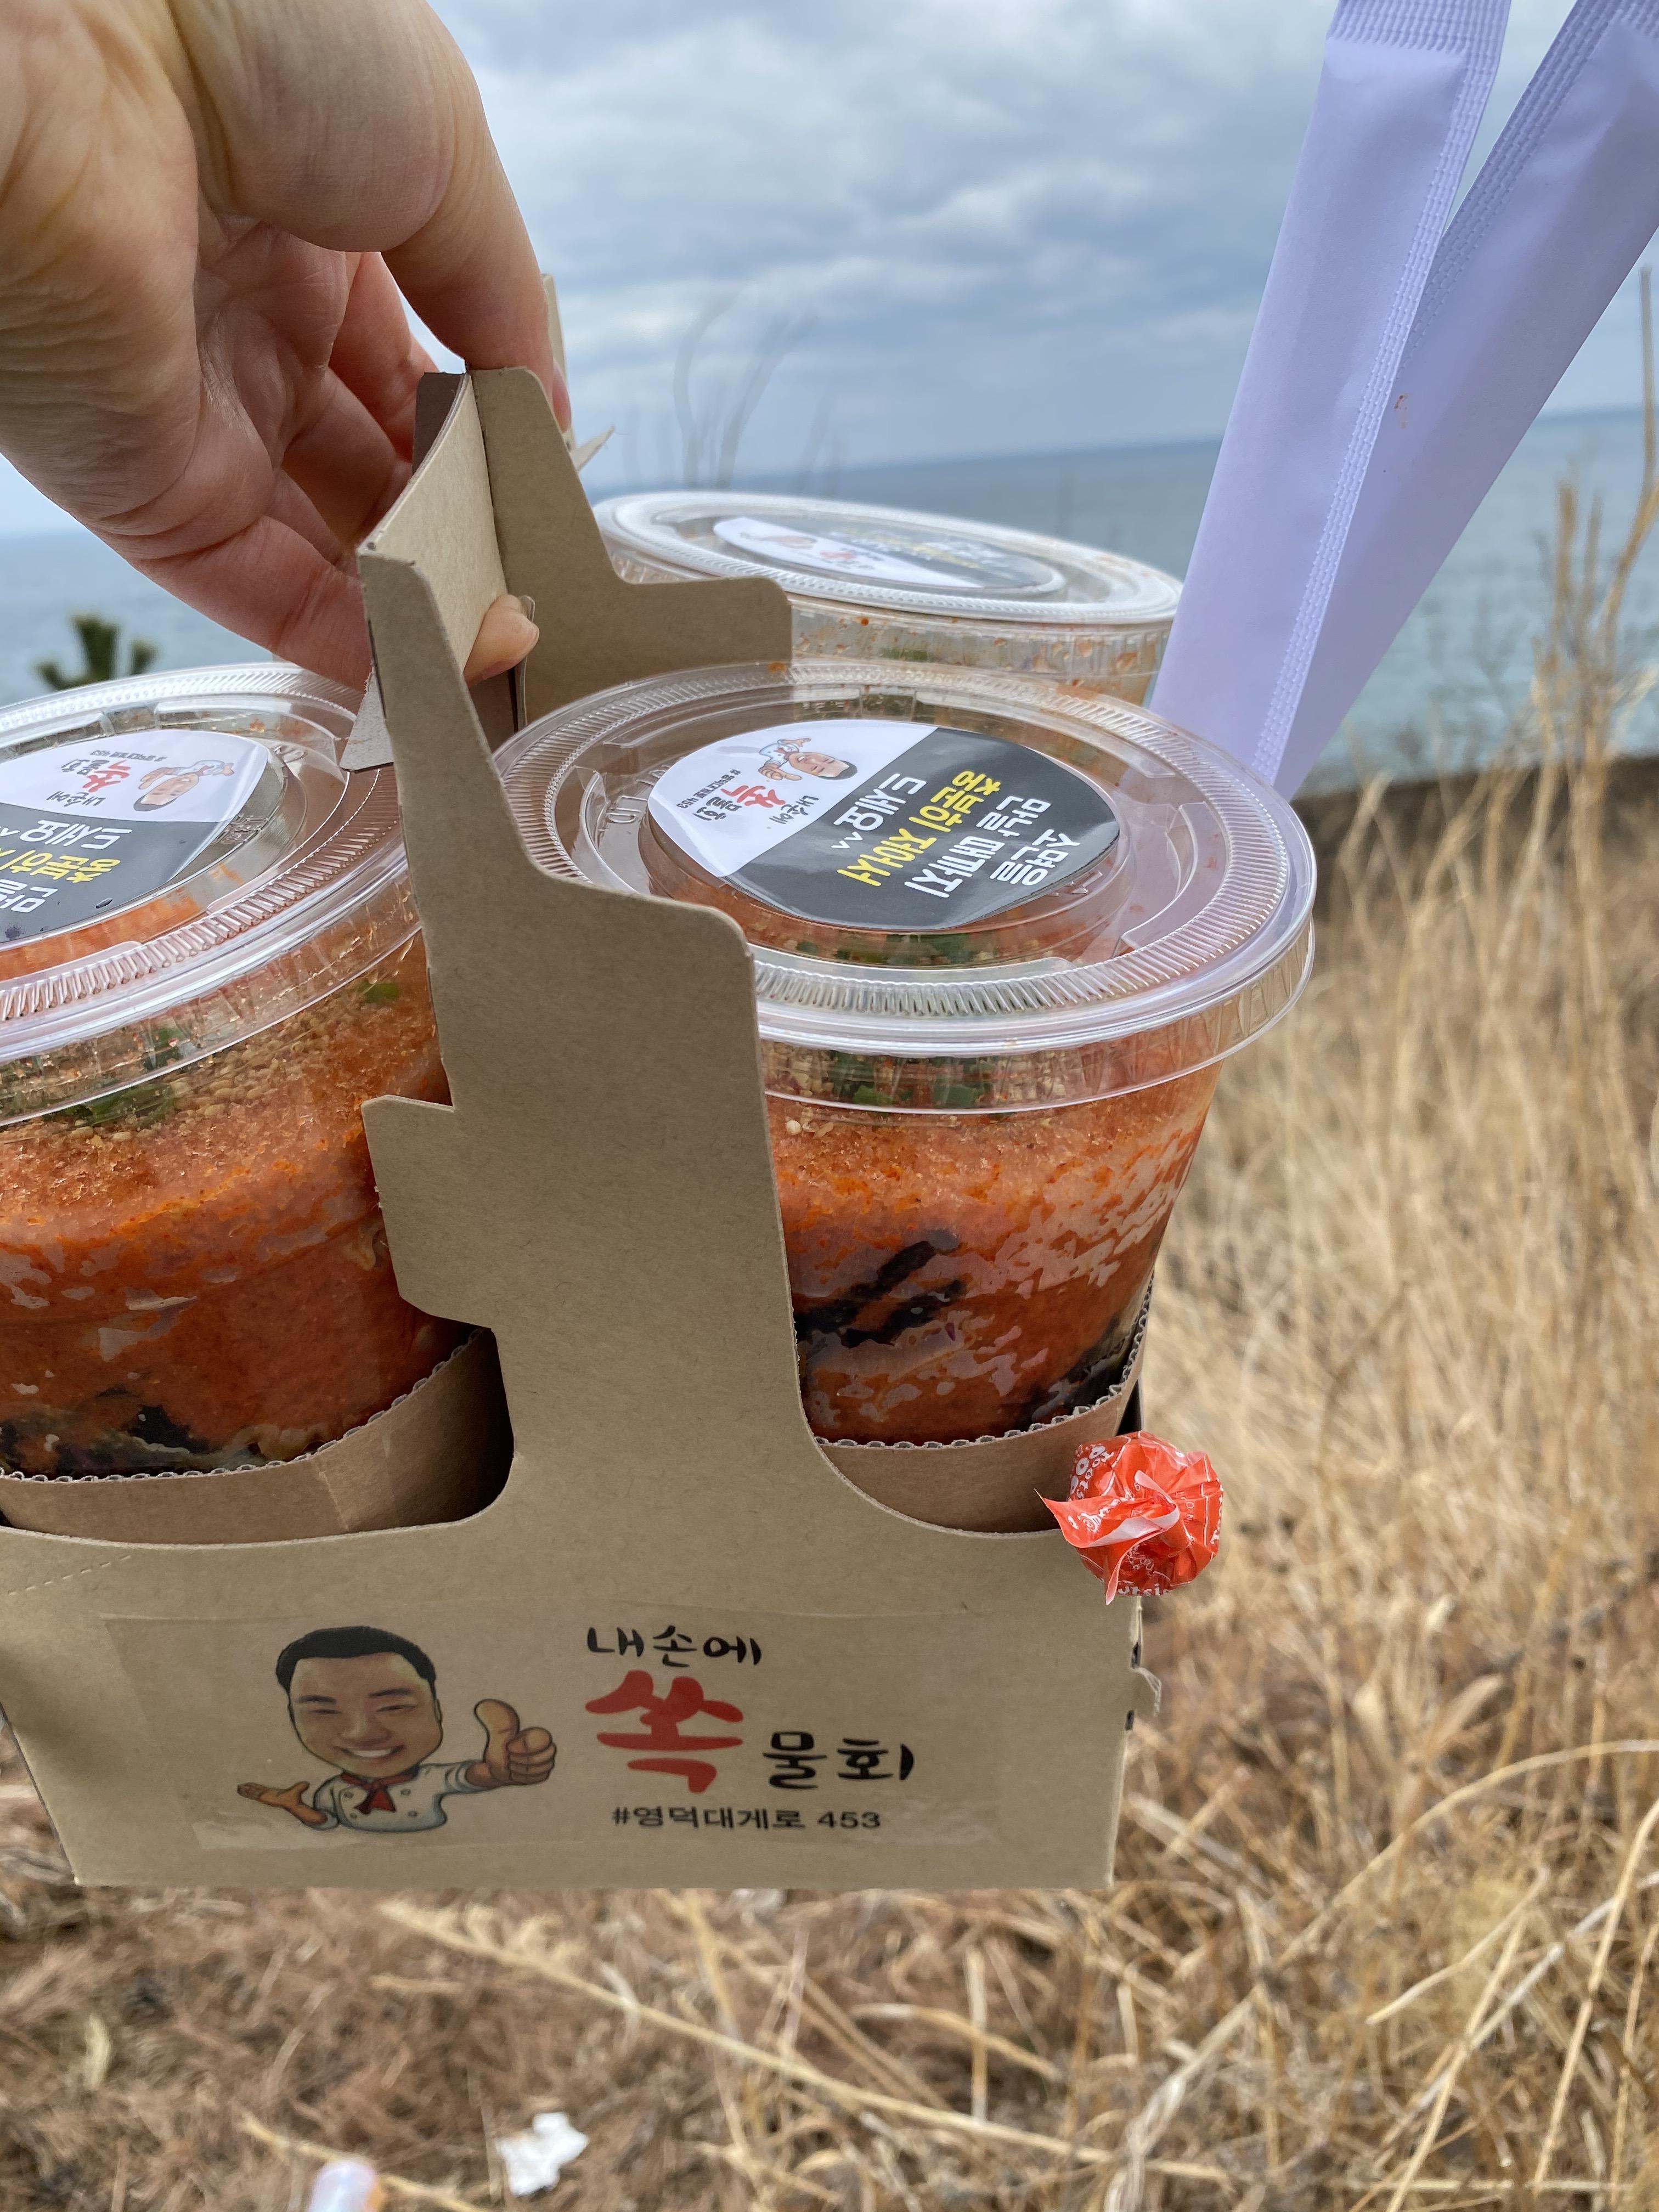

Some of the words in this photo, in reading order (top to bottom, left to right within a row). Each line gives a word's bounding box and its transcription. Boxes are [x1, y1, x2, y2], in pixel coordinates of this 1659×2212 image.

[909, 770, 1001, 832] 충분히
[975, 795, 1052, 837] 만날
[0, 850, 121, 883] 충분히
[837, 828, 937, 887] 저어서
[904, 836, 1005, 898] 때까지
[989, 828, 1080, 886] 소면을
[586, 1625, 761, 1668] 내손에
[763, 1731, 914, 1790] 물회
[817, 1811, 881, 1829] 453
